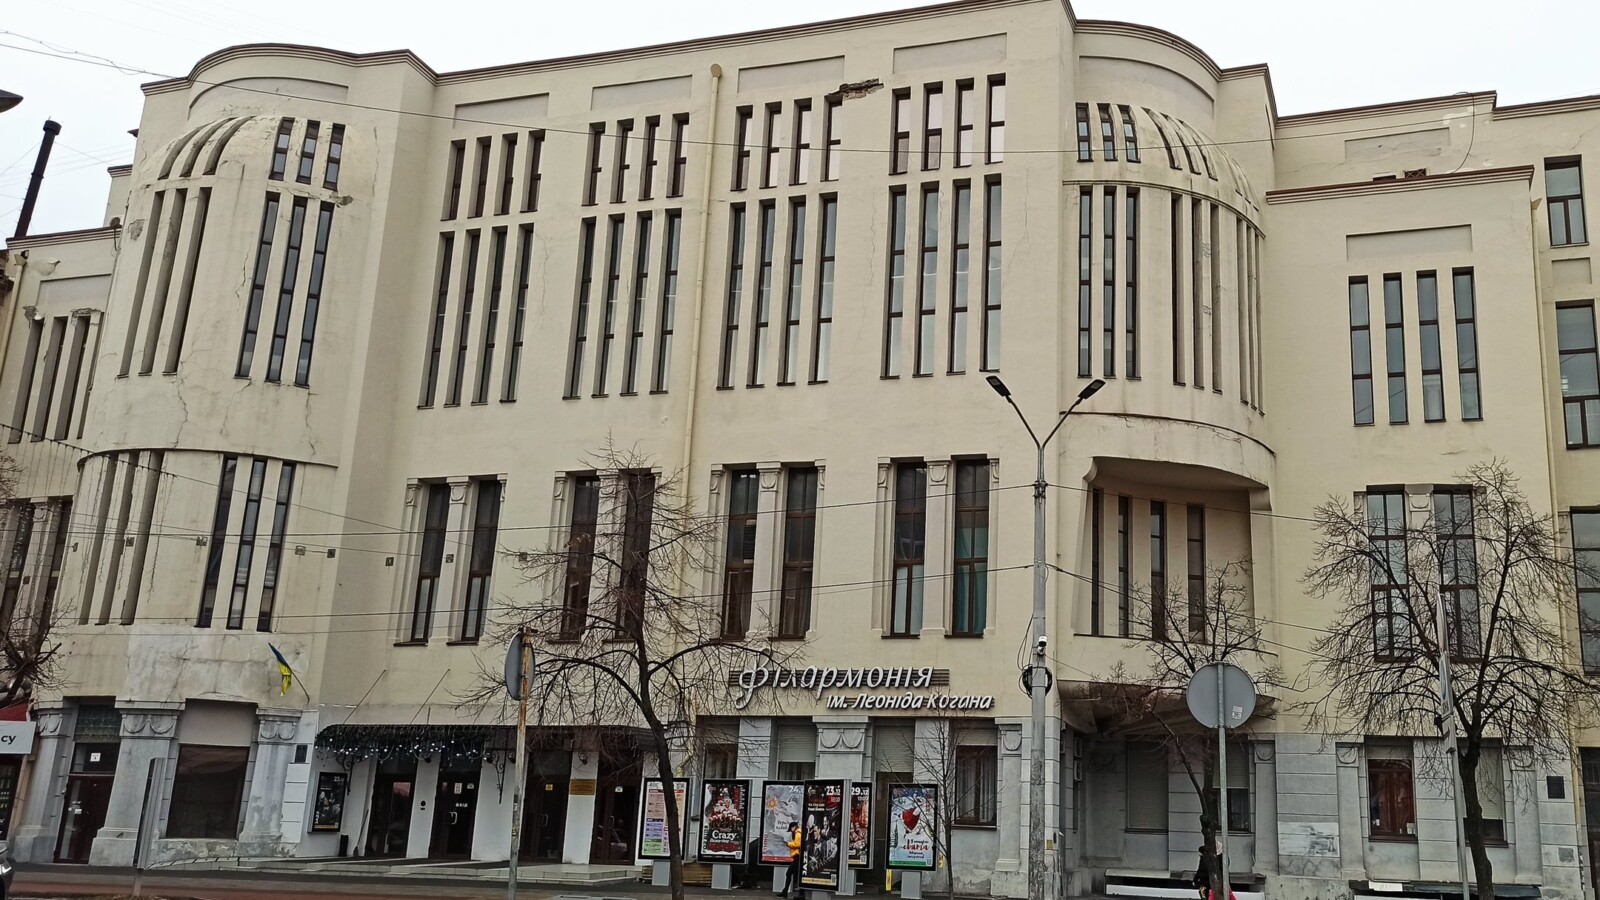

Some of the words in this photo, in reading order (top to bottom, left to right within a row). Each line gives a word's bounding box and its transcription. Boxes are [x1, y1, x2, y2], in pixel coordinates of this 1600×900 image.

[735, 648, 934, 710] Філармонія
[851, 691, 922, 709] Леоніда
[926, 694, 992, 709] Когана
[712, 829, 737, 841] Crazy
